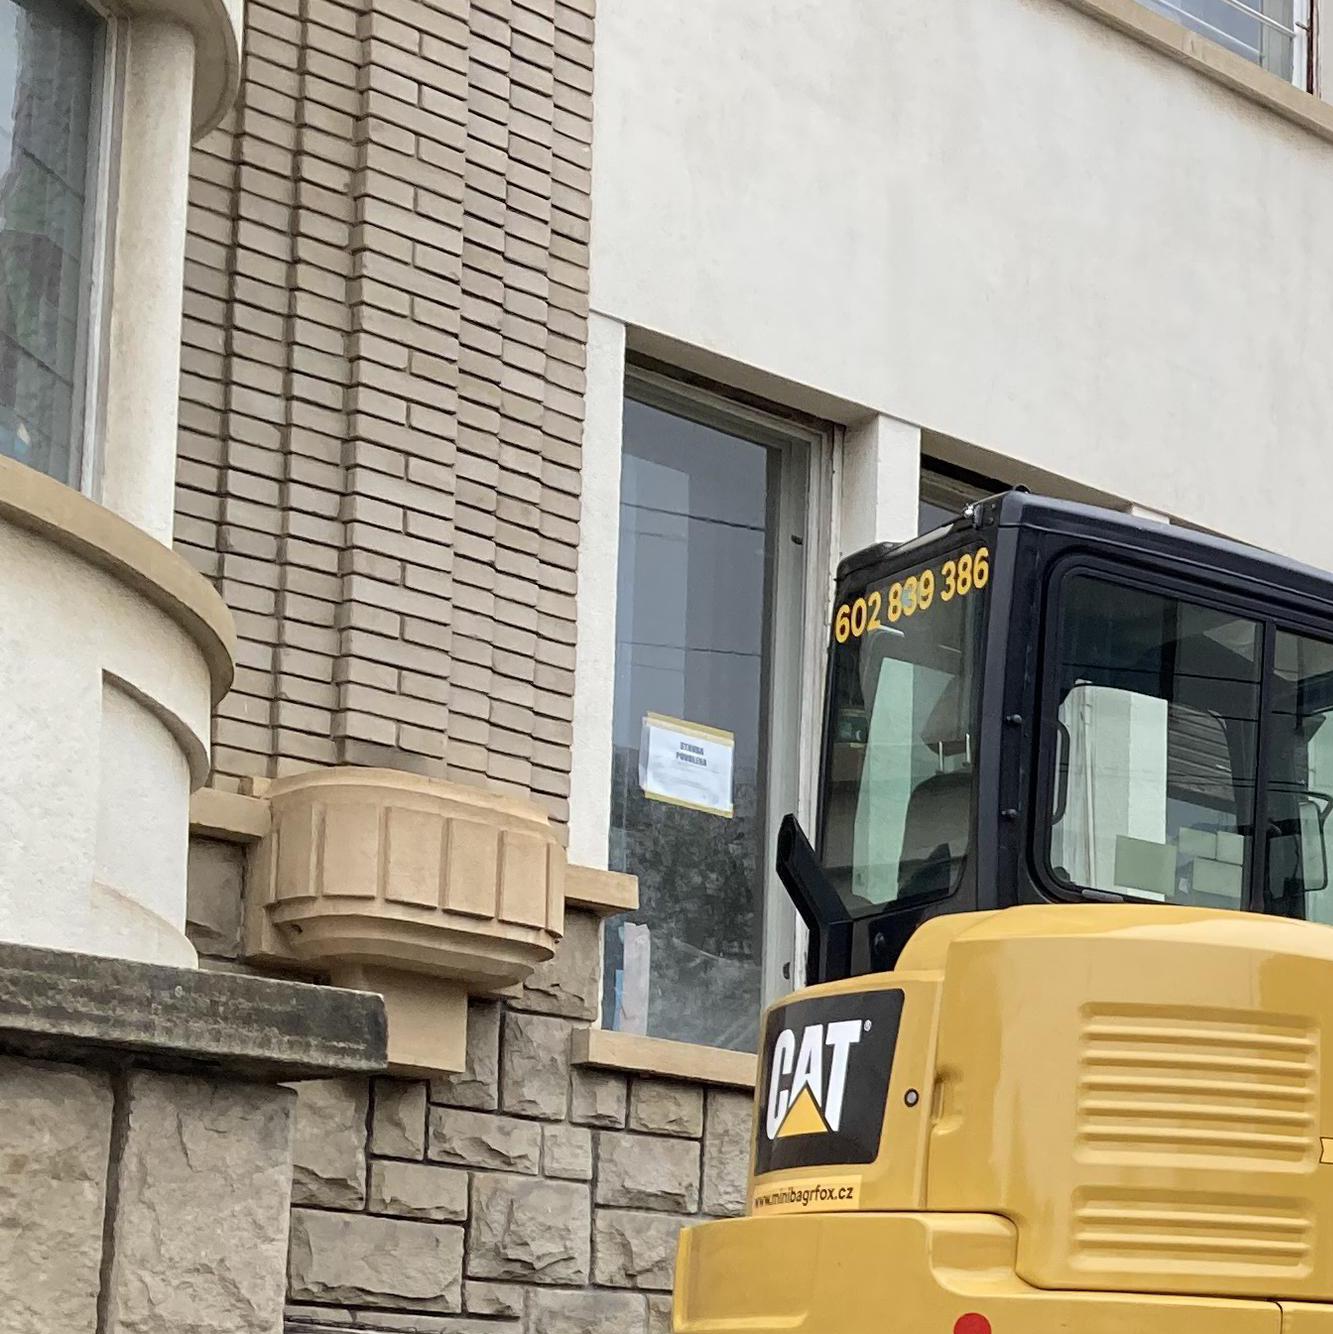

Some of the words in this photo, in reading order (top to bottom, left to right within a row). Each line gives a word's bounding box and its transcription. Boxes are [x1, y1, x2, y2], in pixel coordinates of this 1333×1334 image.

[835, 591, 882, 643] 602
[887, 569, 935, 622] 839
[940, 547, 989, 601] 386
[766, 1019, 863, 1140] CAT
